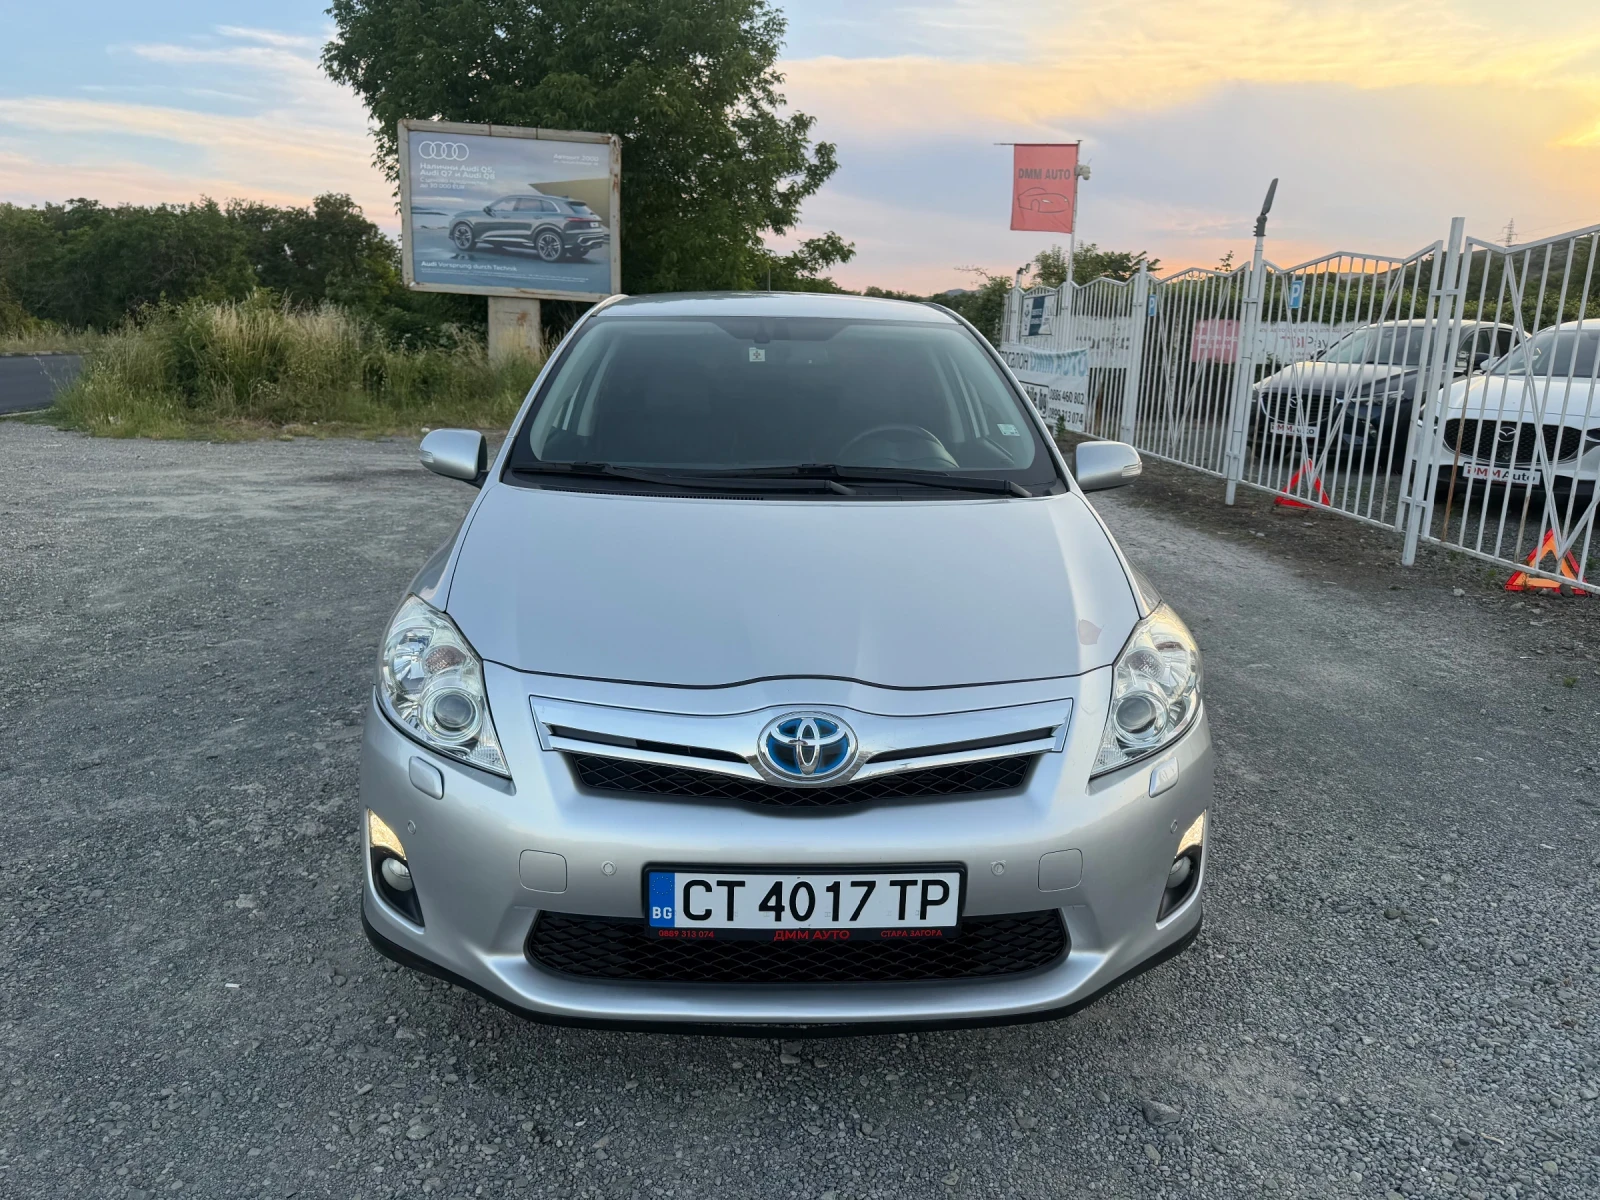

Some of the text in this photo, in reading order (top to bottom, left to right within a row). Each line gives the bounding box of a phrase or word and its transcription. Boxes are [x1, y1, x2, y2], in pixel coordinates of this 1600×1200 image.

[420, 162, 459, 171] Налични
[1018, 168, 1071, 180] DMM AUTO
[438, 262, 472, 270] Vorsprung
[493, 264, 517, 272] Technik
[1290, 284, 1300, 306] P
[652, 879, 950, 922] BG CT 4017 TP
[658, 929, 680, 937] 0889
[681, 930, 697, 938] 313
[698, 930, 715, 938] 074
[773, 930, 809, 941] ДММ
[813, 930, 850, 940] АУТО
[910, 929, 943, 937] ЗАГОРА
